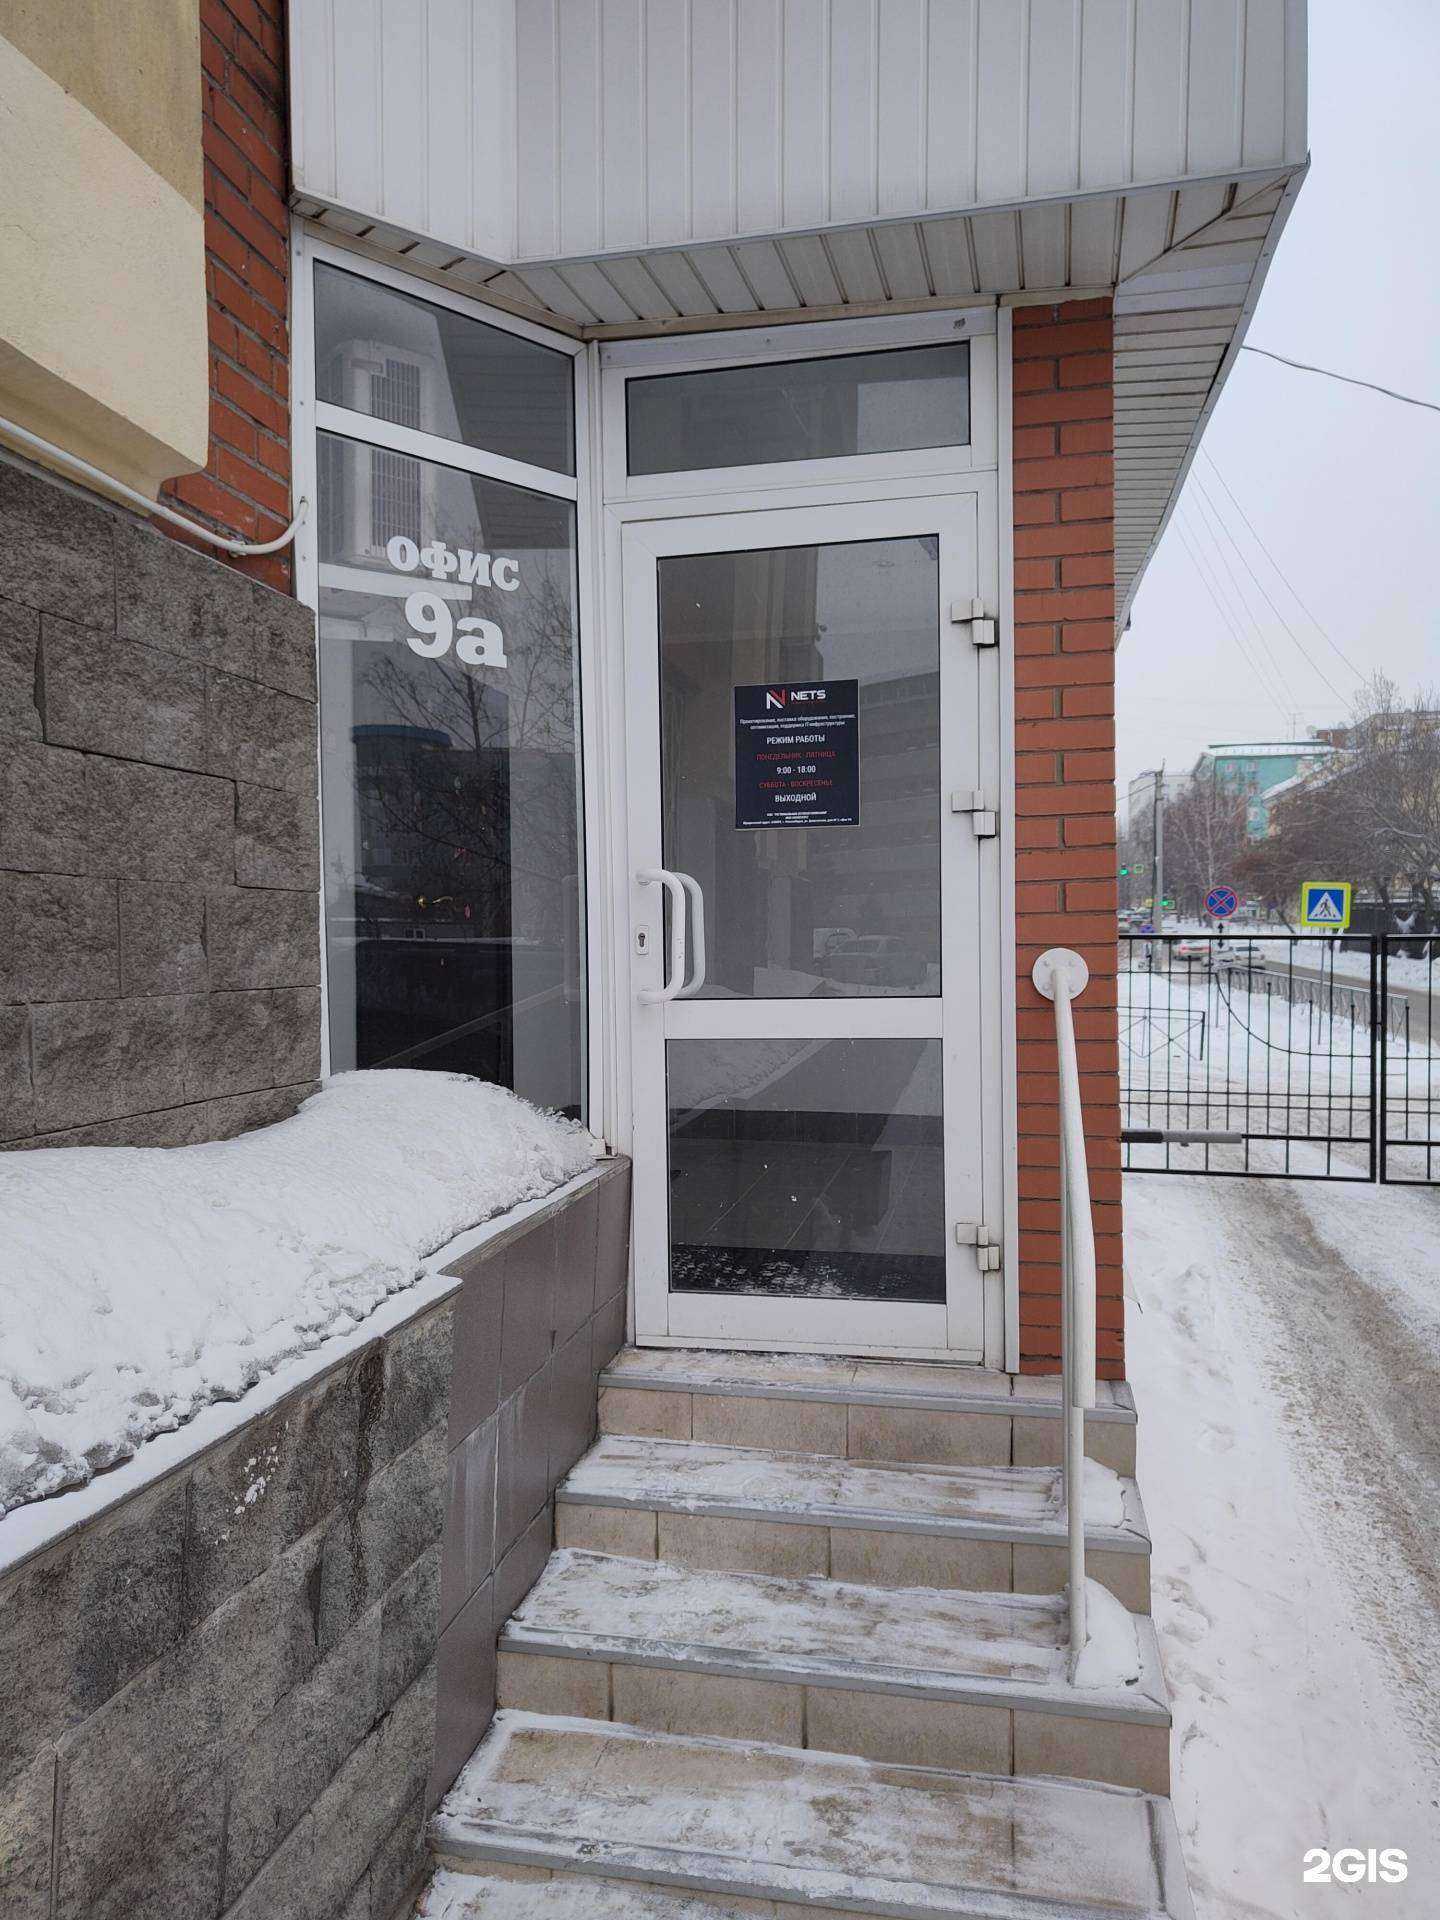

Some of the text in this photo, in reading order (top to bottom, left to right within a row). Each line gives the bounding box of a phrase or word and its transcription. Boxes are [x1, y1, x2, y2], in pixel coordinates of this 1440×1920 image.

[405, 591, 508, 669] 9а
[790, 689, 826, 701] NETS
[766, 734, 825, 745] РЕЖИМ РАБОТЫ
[806, 750, 836, 759] ПЯТНИЦА
[776, 766, 792, 775] 9:00
[797, 765, 817, 774] 18:00
[759, 781, 786, 789] СУББОТА
[775, 792, 817, 803] ВЫХОДНОЙ
